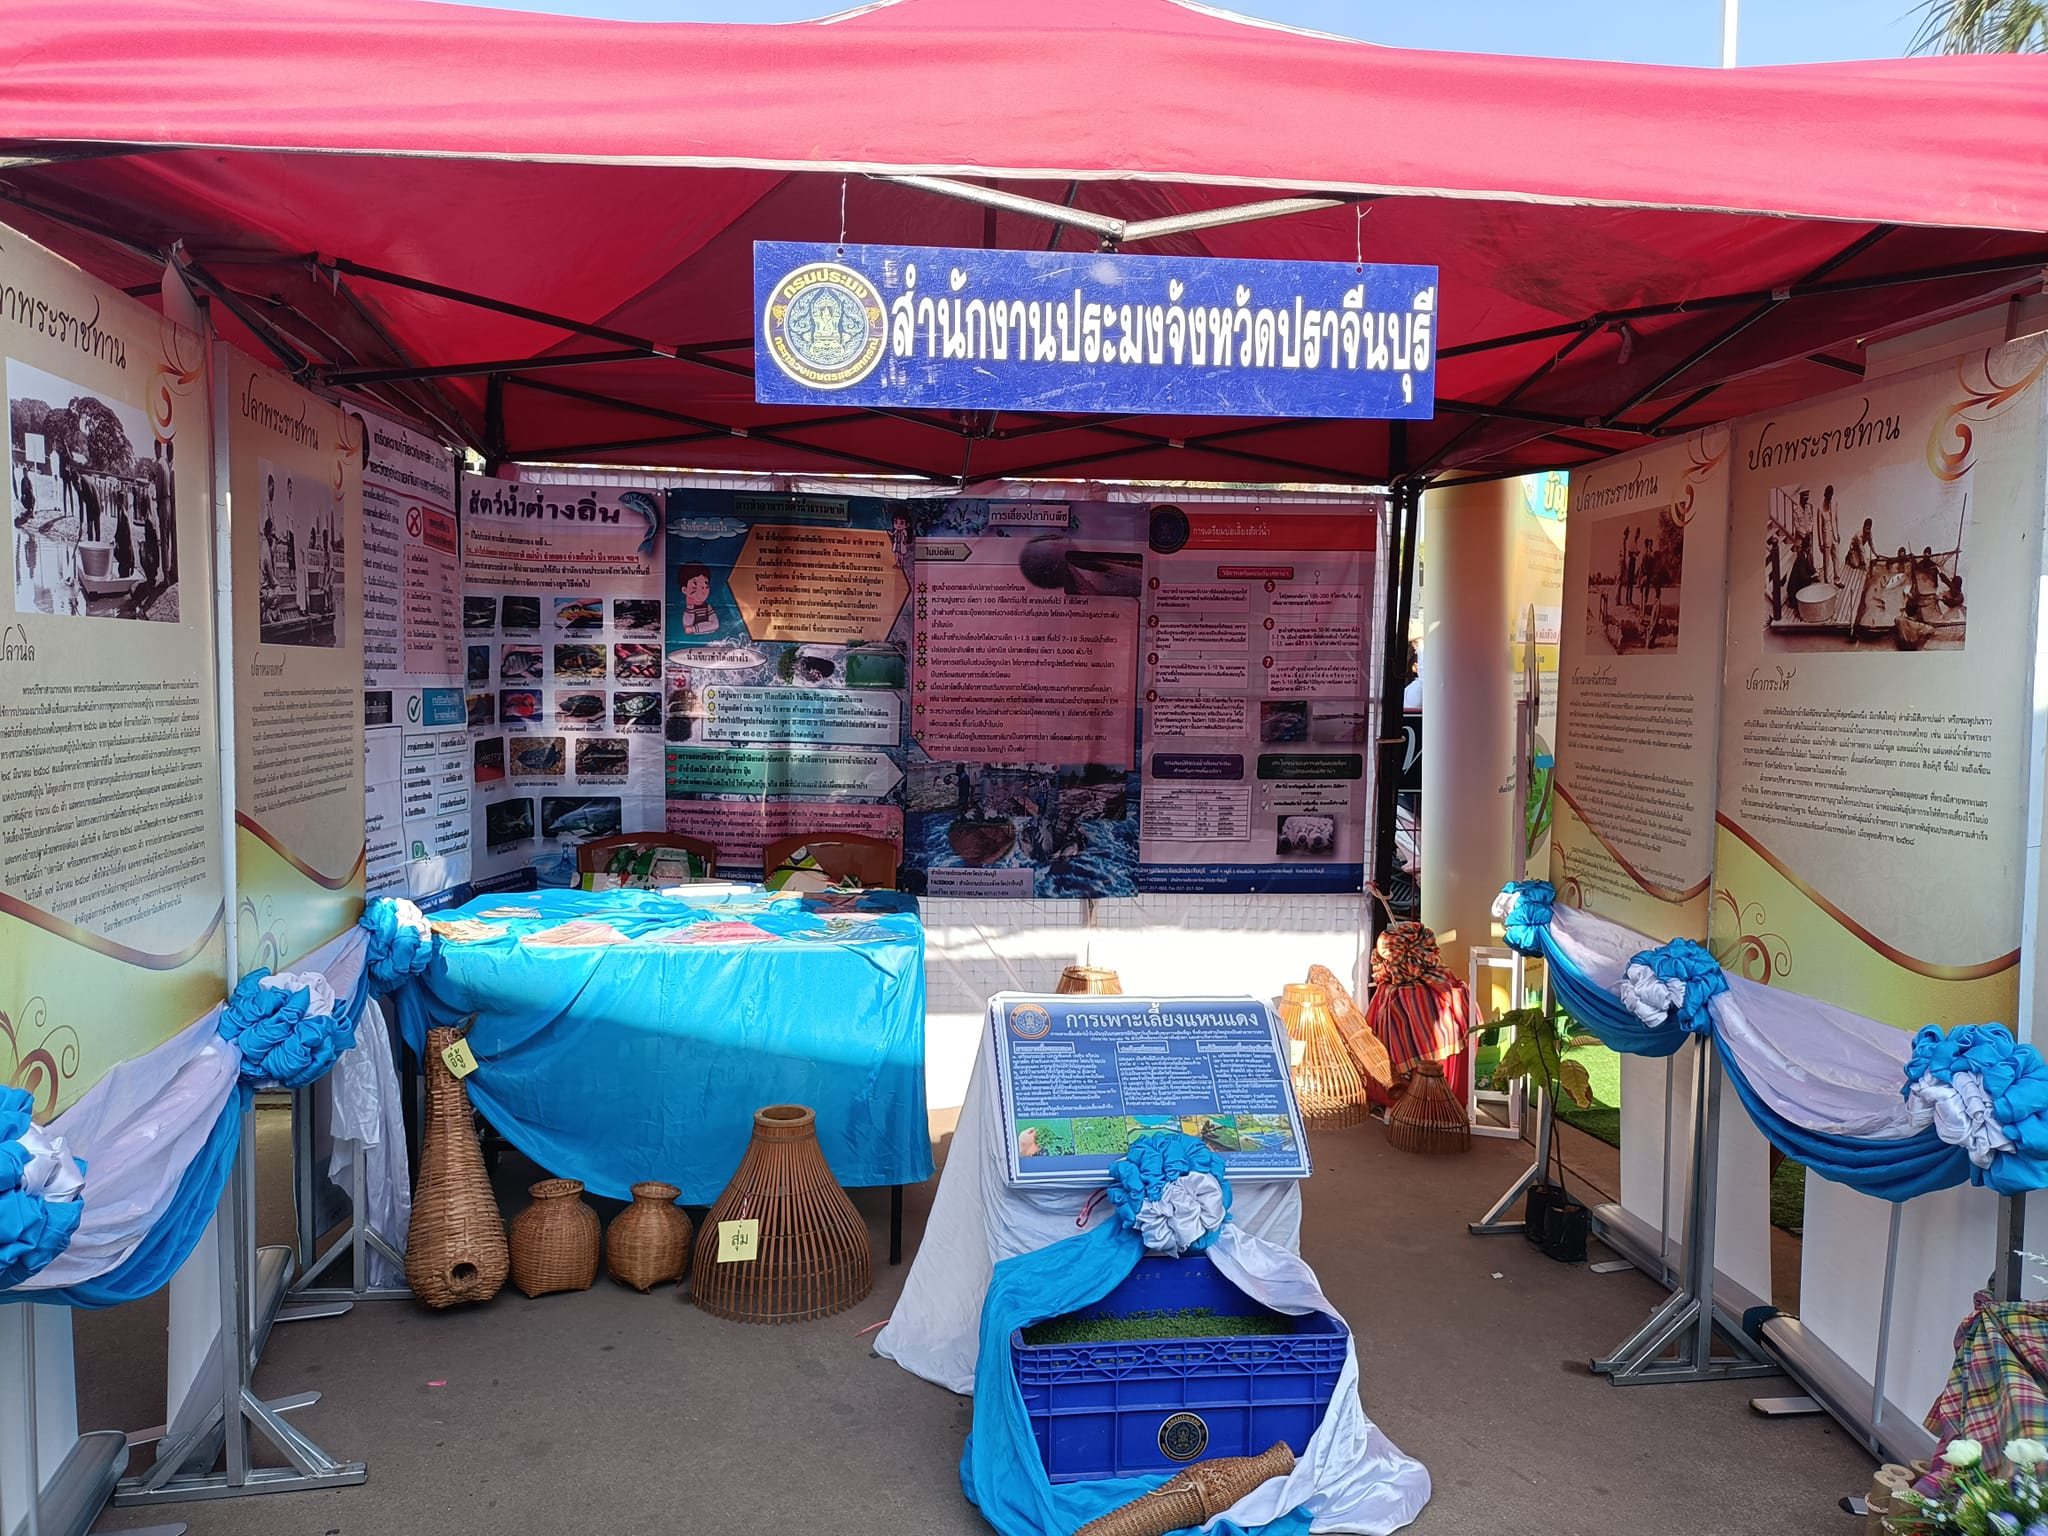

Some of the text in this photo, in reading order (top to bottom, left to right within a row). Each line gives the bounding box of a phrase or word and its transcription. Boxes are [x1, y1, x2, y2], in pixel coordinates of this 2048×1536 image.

[783, 268, 868, 299] กรมประมง
[890, 262, 1435, 403] สำนักงานประมงจังหวัดปราจีนบุรี
[241, 385, 320, 452] ปลาพระราชทาน
[1749, 398, 1901, 470] ปลาพระราชทาน
[469, 485, 620, 524] สัตว์น้ำต่างถิ่น
[1577, 460, 1659, 513] ปลาพระราชทาน
[1746, 666, 1797, 691] ปลากระโห้
[1065, 1002, 1259, 1029] การเพาะเลี้ยงแหนแดง
